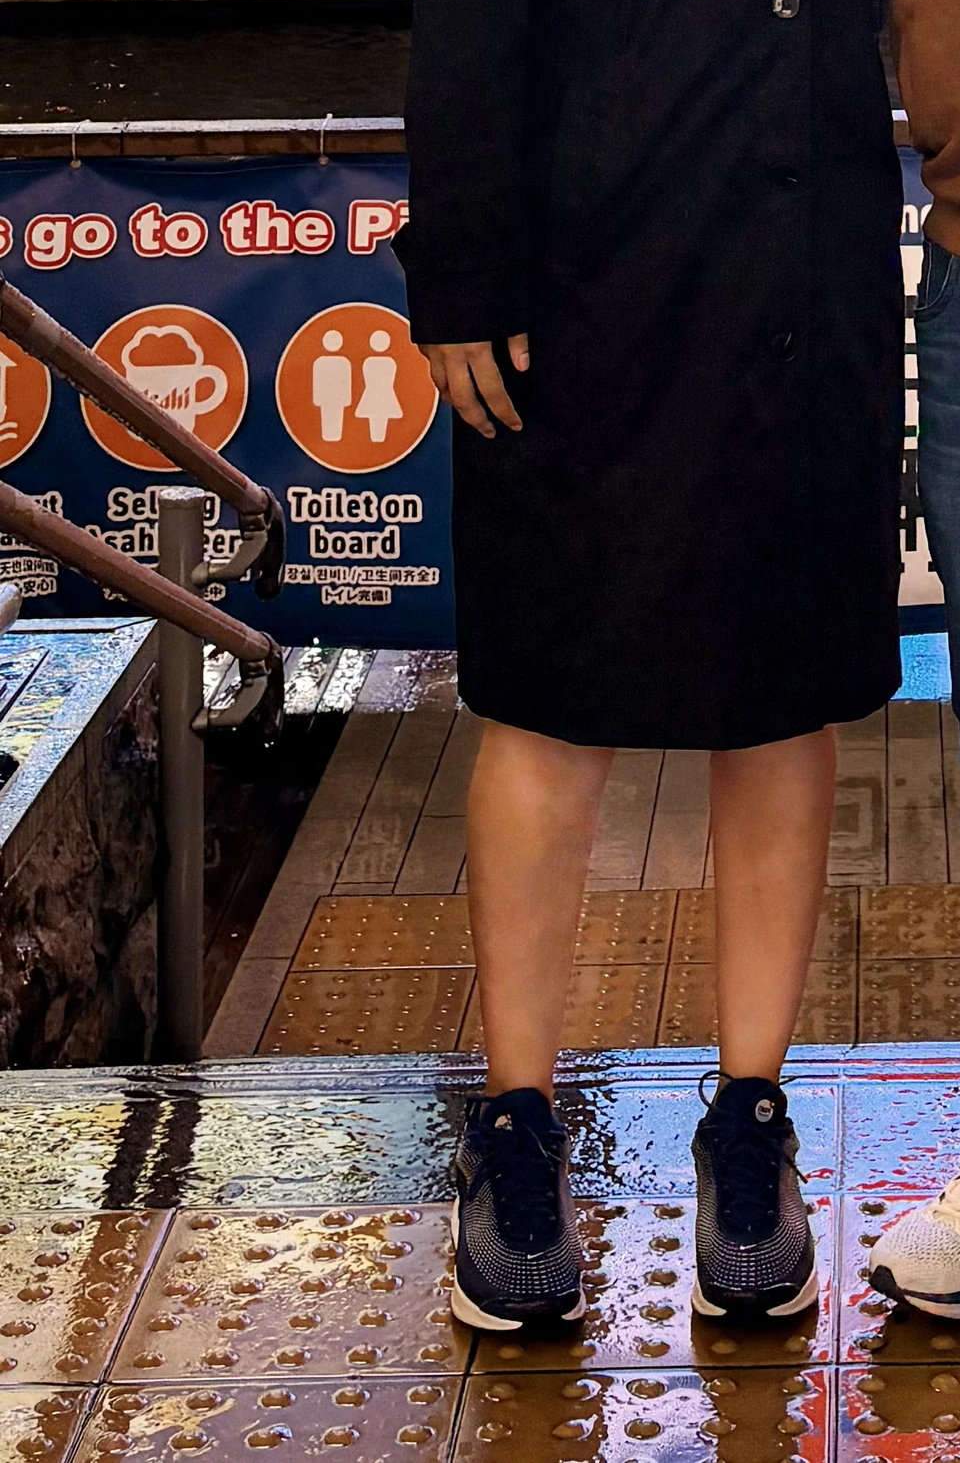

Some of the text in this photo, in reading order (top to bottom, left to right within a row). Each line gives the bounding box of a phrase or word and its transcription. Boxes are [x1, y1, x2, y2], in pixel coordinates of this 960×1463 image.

[26, 214, 116, 269] go
[131, 204, 207, 256] to
[222, 201, 334, 253] the
[112, 490, 216, 521] Selg
[291, 490, 418, 518] Toilet on
[313, 528, 396, 555] board
